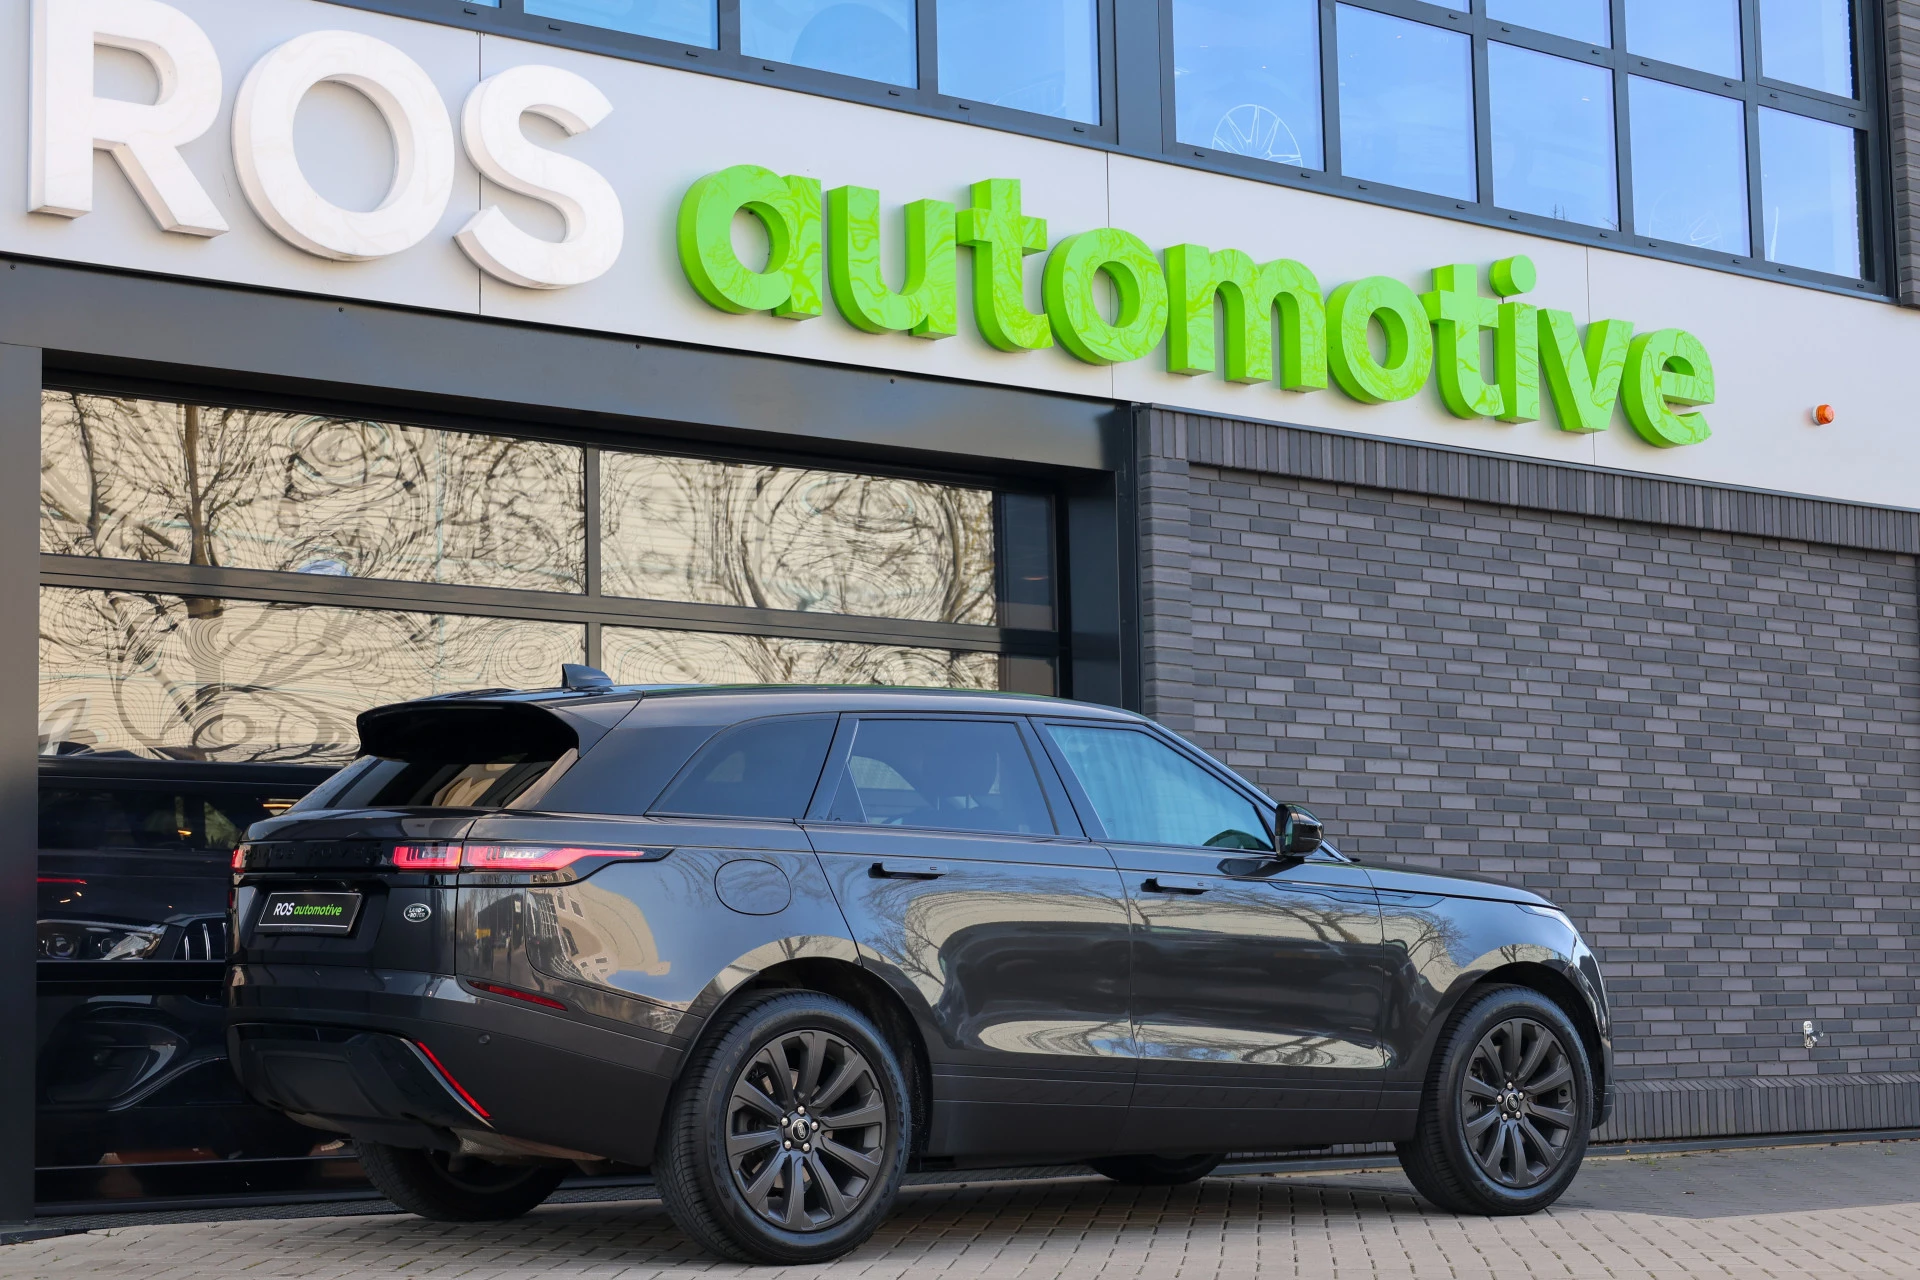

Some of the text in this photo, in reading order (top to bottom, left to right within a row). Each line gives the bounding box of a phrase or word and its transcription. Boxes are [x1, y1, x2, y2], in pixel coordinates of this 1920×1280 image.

[28, 0, 1716, 449] ROS automotive
[273, 902, 343, 916] ROS automotive
